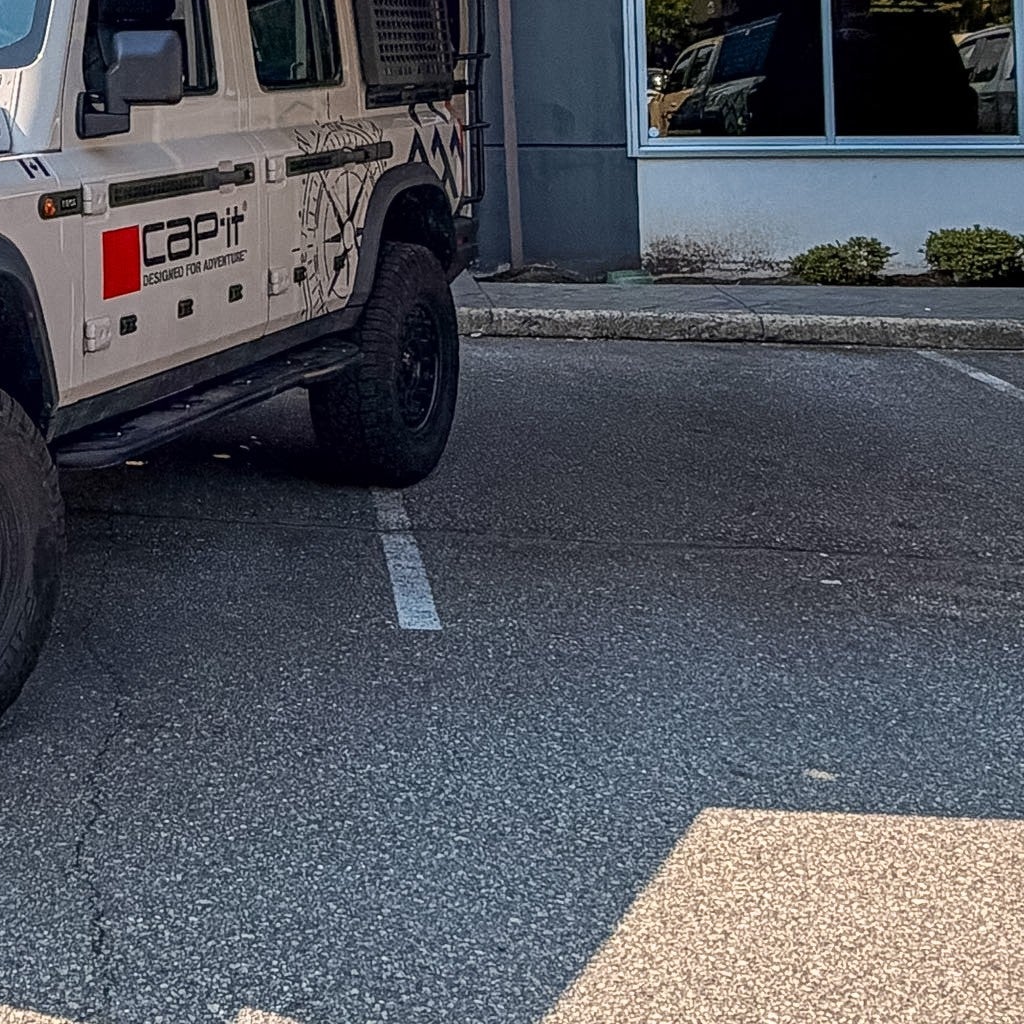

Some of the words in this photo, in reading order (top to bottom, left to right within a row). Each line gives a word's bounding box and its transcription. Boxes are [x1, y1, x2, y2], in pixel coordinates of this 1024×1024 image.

[143, 266, 184, 287] DESIGNED
[185, 260, 202, 277] FOR
[203, 251, 246, 272] ADVENTURE
